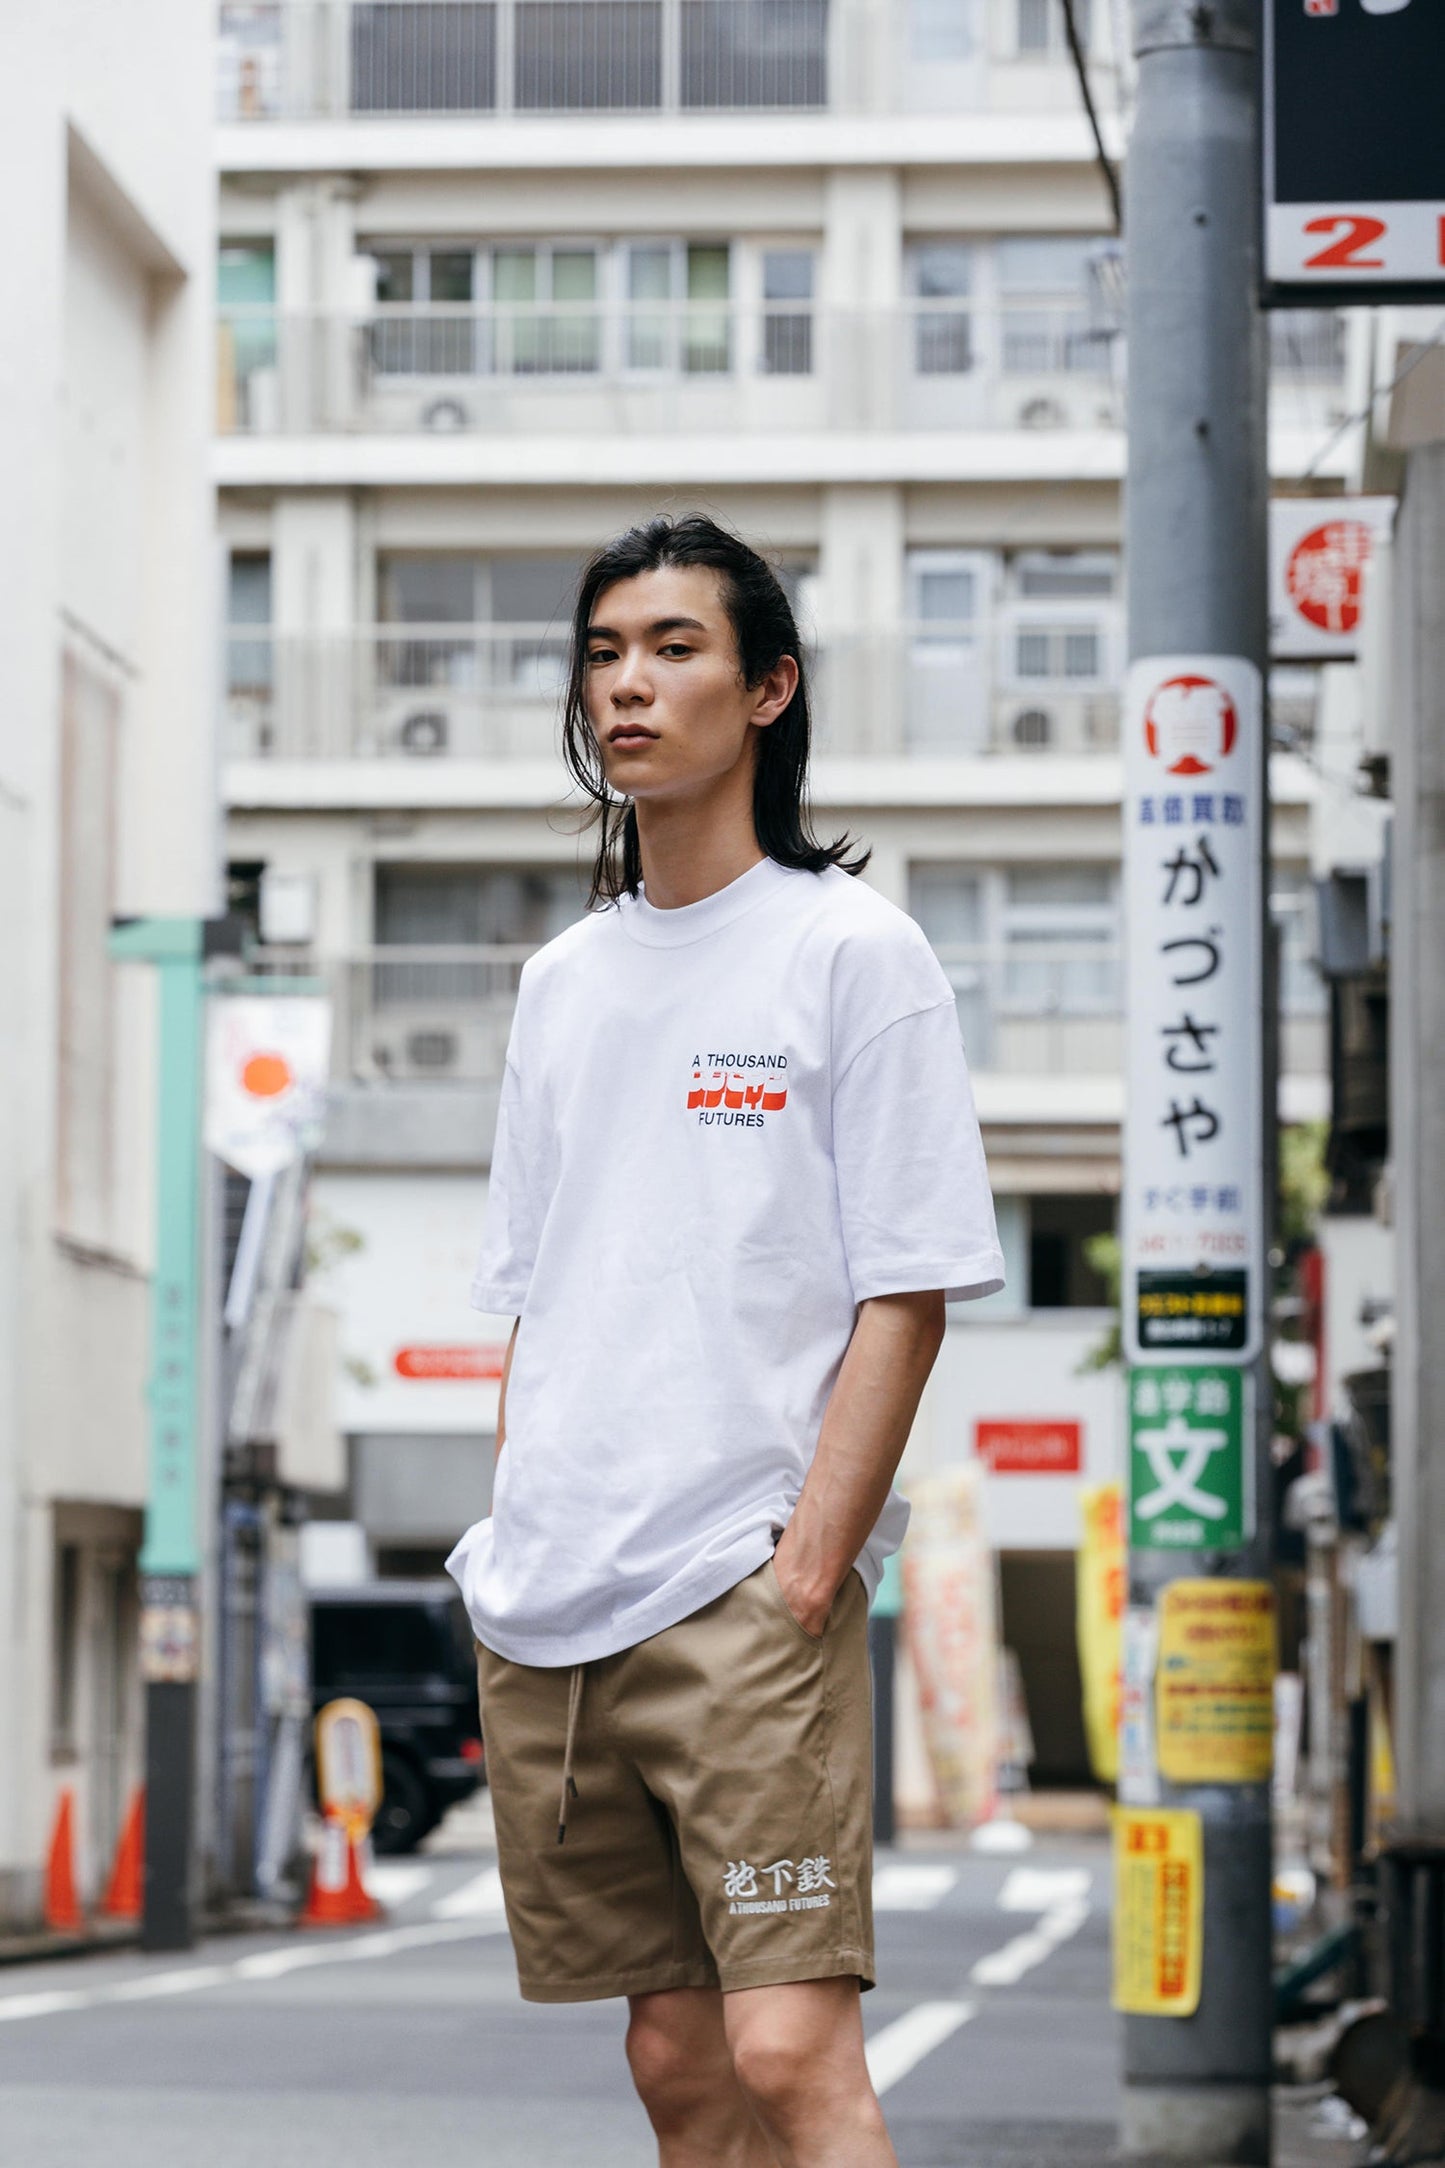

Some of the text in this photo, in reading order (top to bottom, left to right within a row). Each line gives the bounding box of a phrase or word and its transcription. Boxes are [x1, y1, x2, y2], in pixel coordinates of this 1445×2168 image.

[1162, 835, 1220, 1156] かづさや
[692, 1054, 787, 1069] A THOUSAND
[699, 1112, 764, 1127] FUTURES
[1135, 1415, 1228, 1520] 文
[737, 1900, 787, 1914] THOUSAND
[789, 1894, 830, 1911] FUTURES
